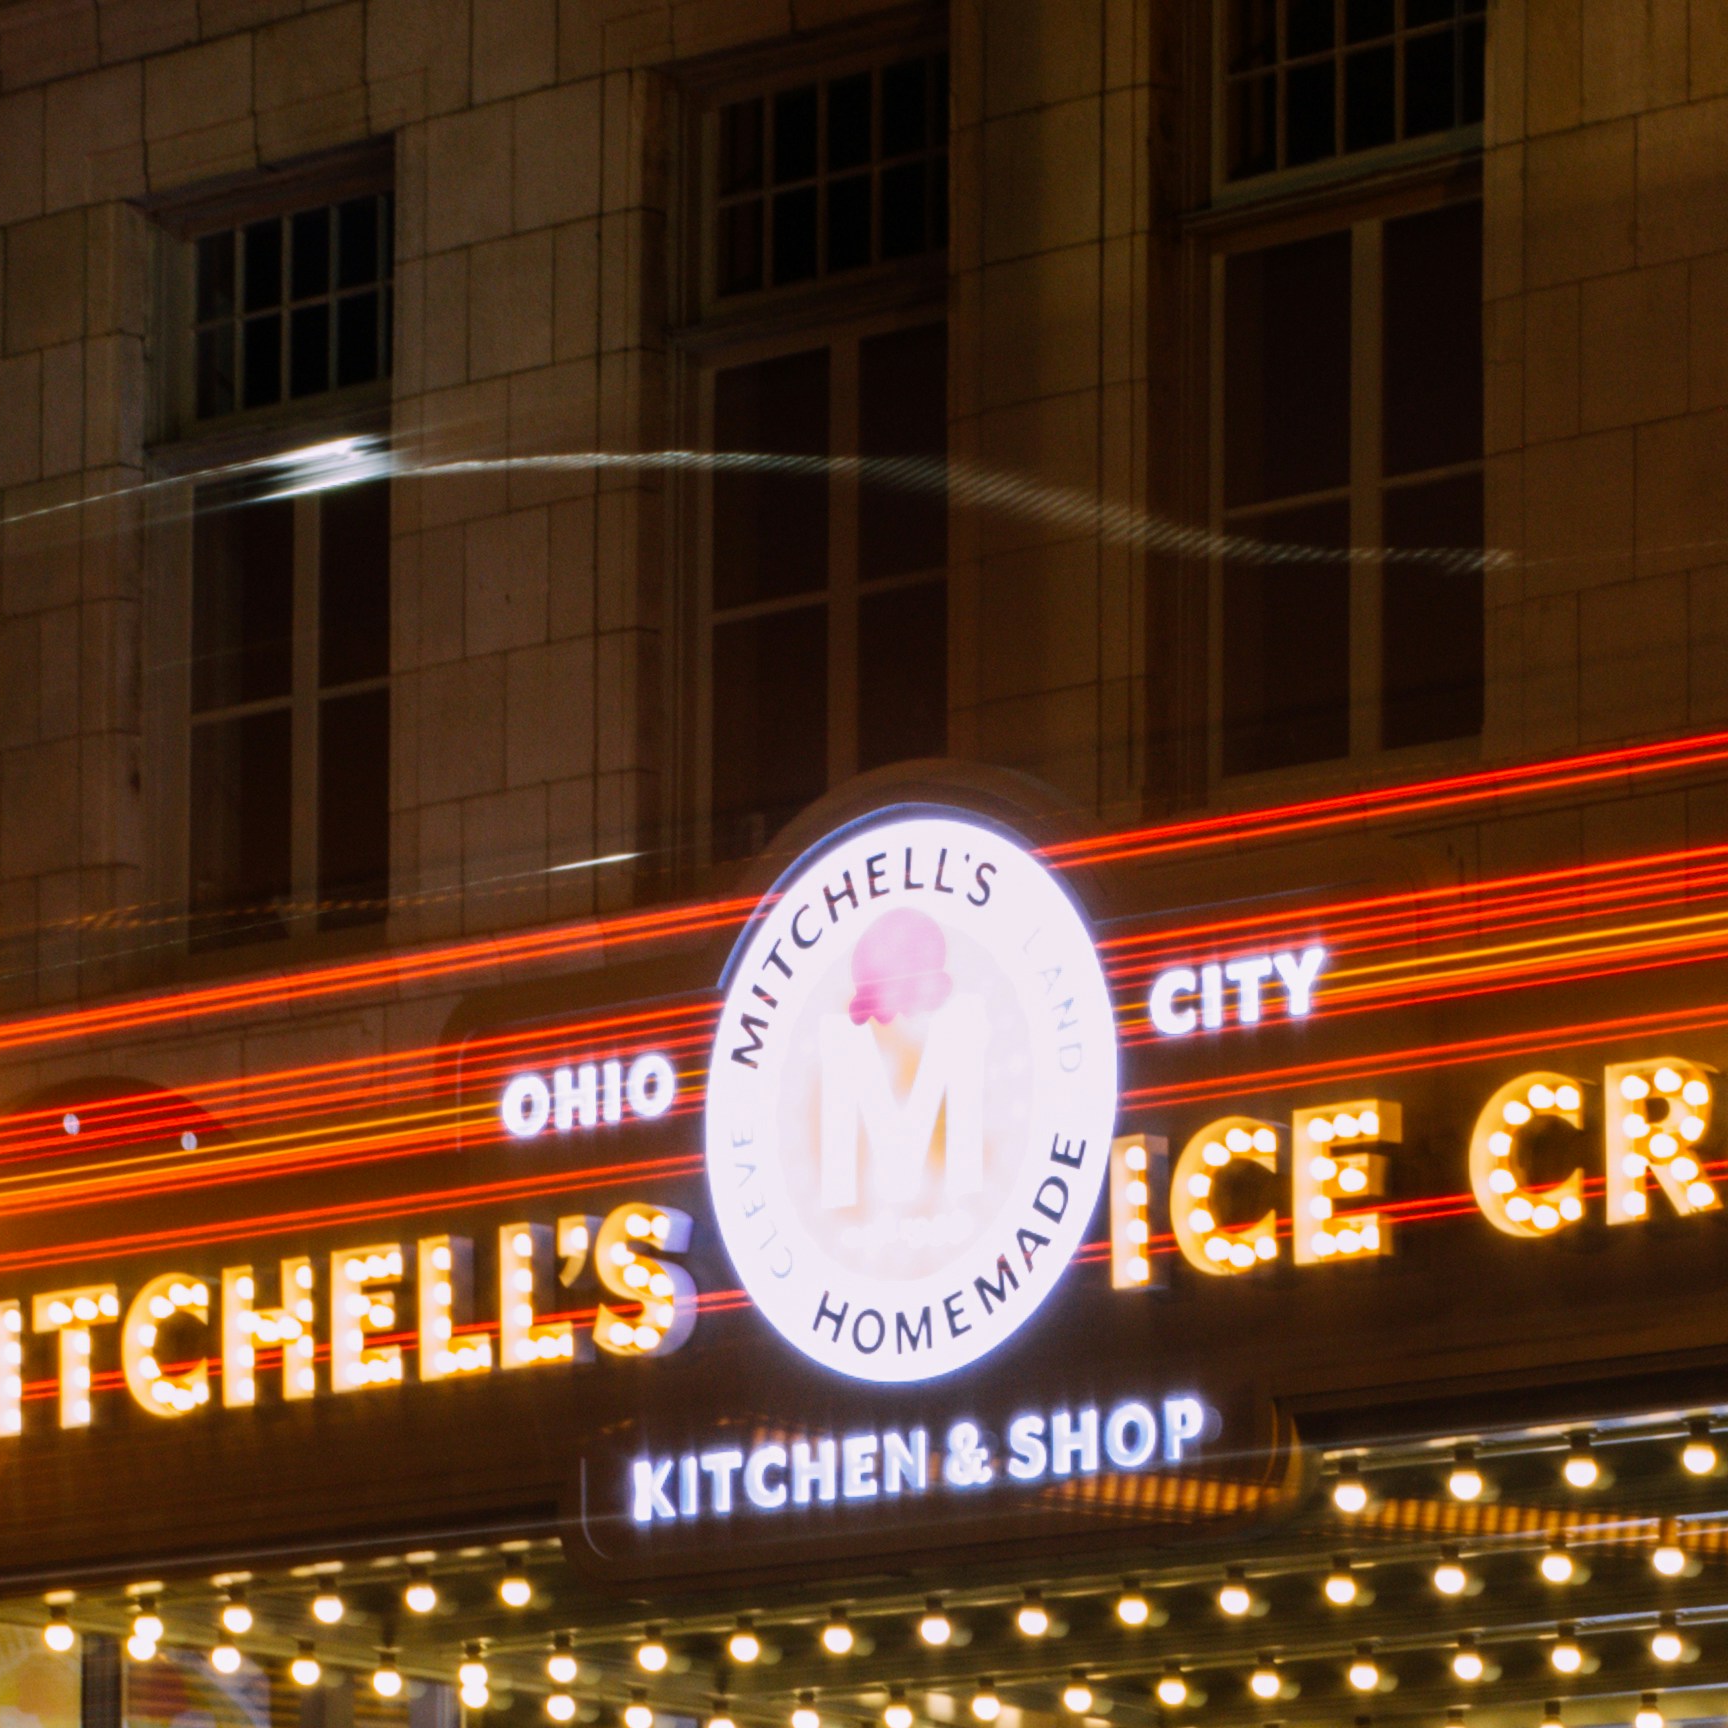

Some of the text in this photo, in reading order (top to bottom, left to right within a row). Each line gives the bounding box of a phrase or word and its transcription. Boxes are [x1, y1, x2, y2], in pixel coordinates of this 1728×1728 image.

[501, 948, 1327, 1139] OHIO CITY
[730, 843, 999, 1069] MITCHELL'S
[812, 1132, 1088, 1355] HOMEMADE
[1109, 1098, 1403, 1293] ICE
[633, 1397, 1206, 1525] KITCHEN & SHOP
